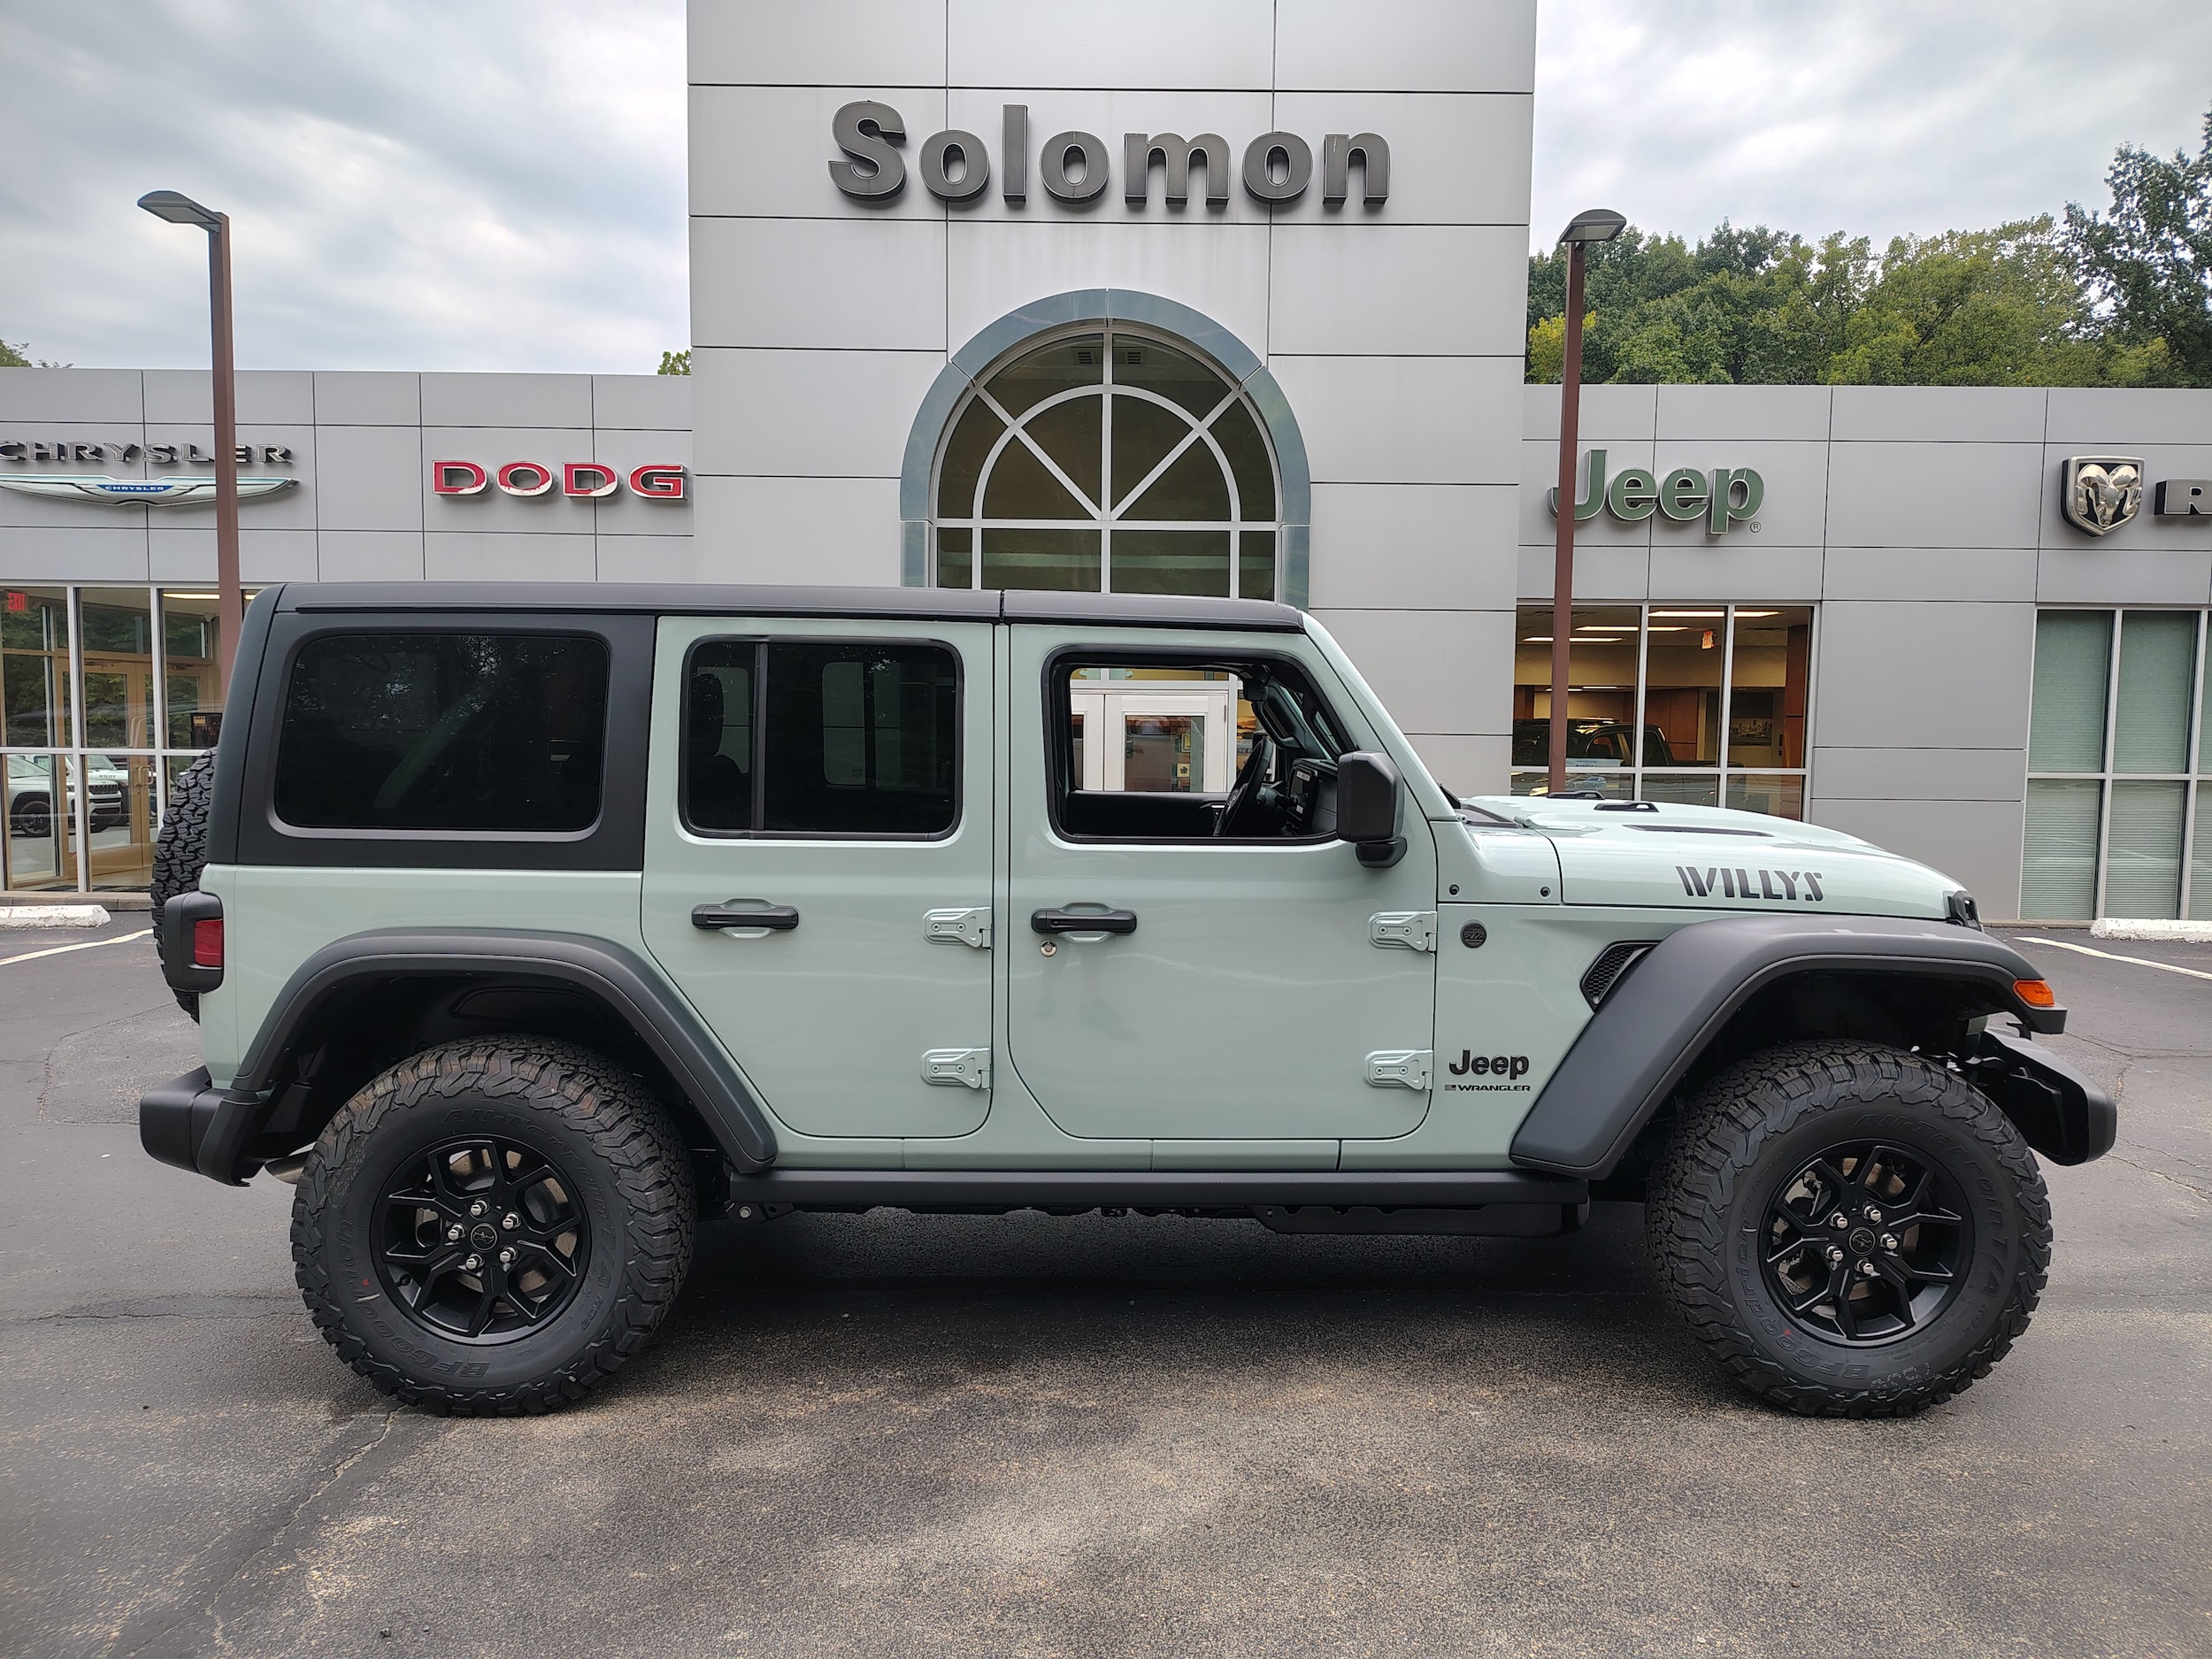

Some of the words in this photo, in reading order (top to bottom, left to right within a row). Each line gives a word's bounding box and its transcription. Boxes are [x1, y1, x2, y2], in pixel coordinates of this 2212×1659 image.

[828, 100, 1391, 205] Solomon
[432, 460, 687, 501] DODG
[1548, 449, 1764, 536] Jeep
[1675, 865, 1824, 902] WILLYS
[1448, 1049, 1529, 1080] Jeep
[1736, 1217, 1870, 1380] BFGoodrich
